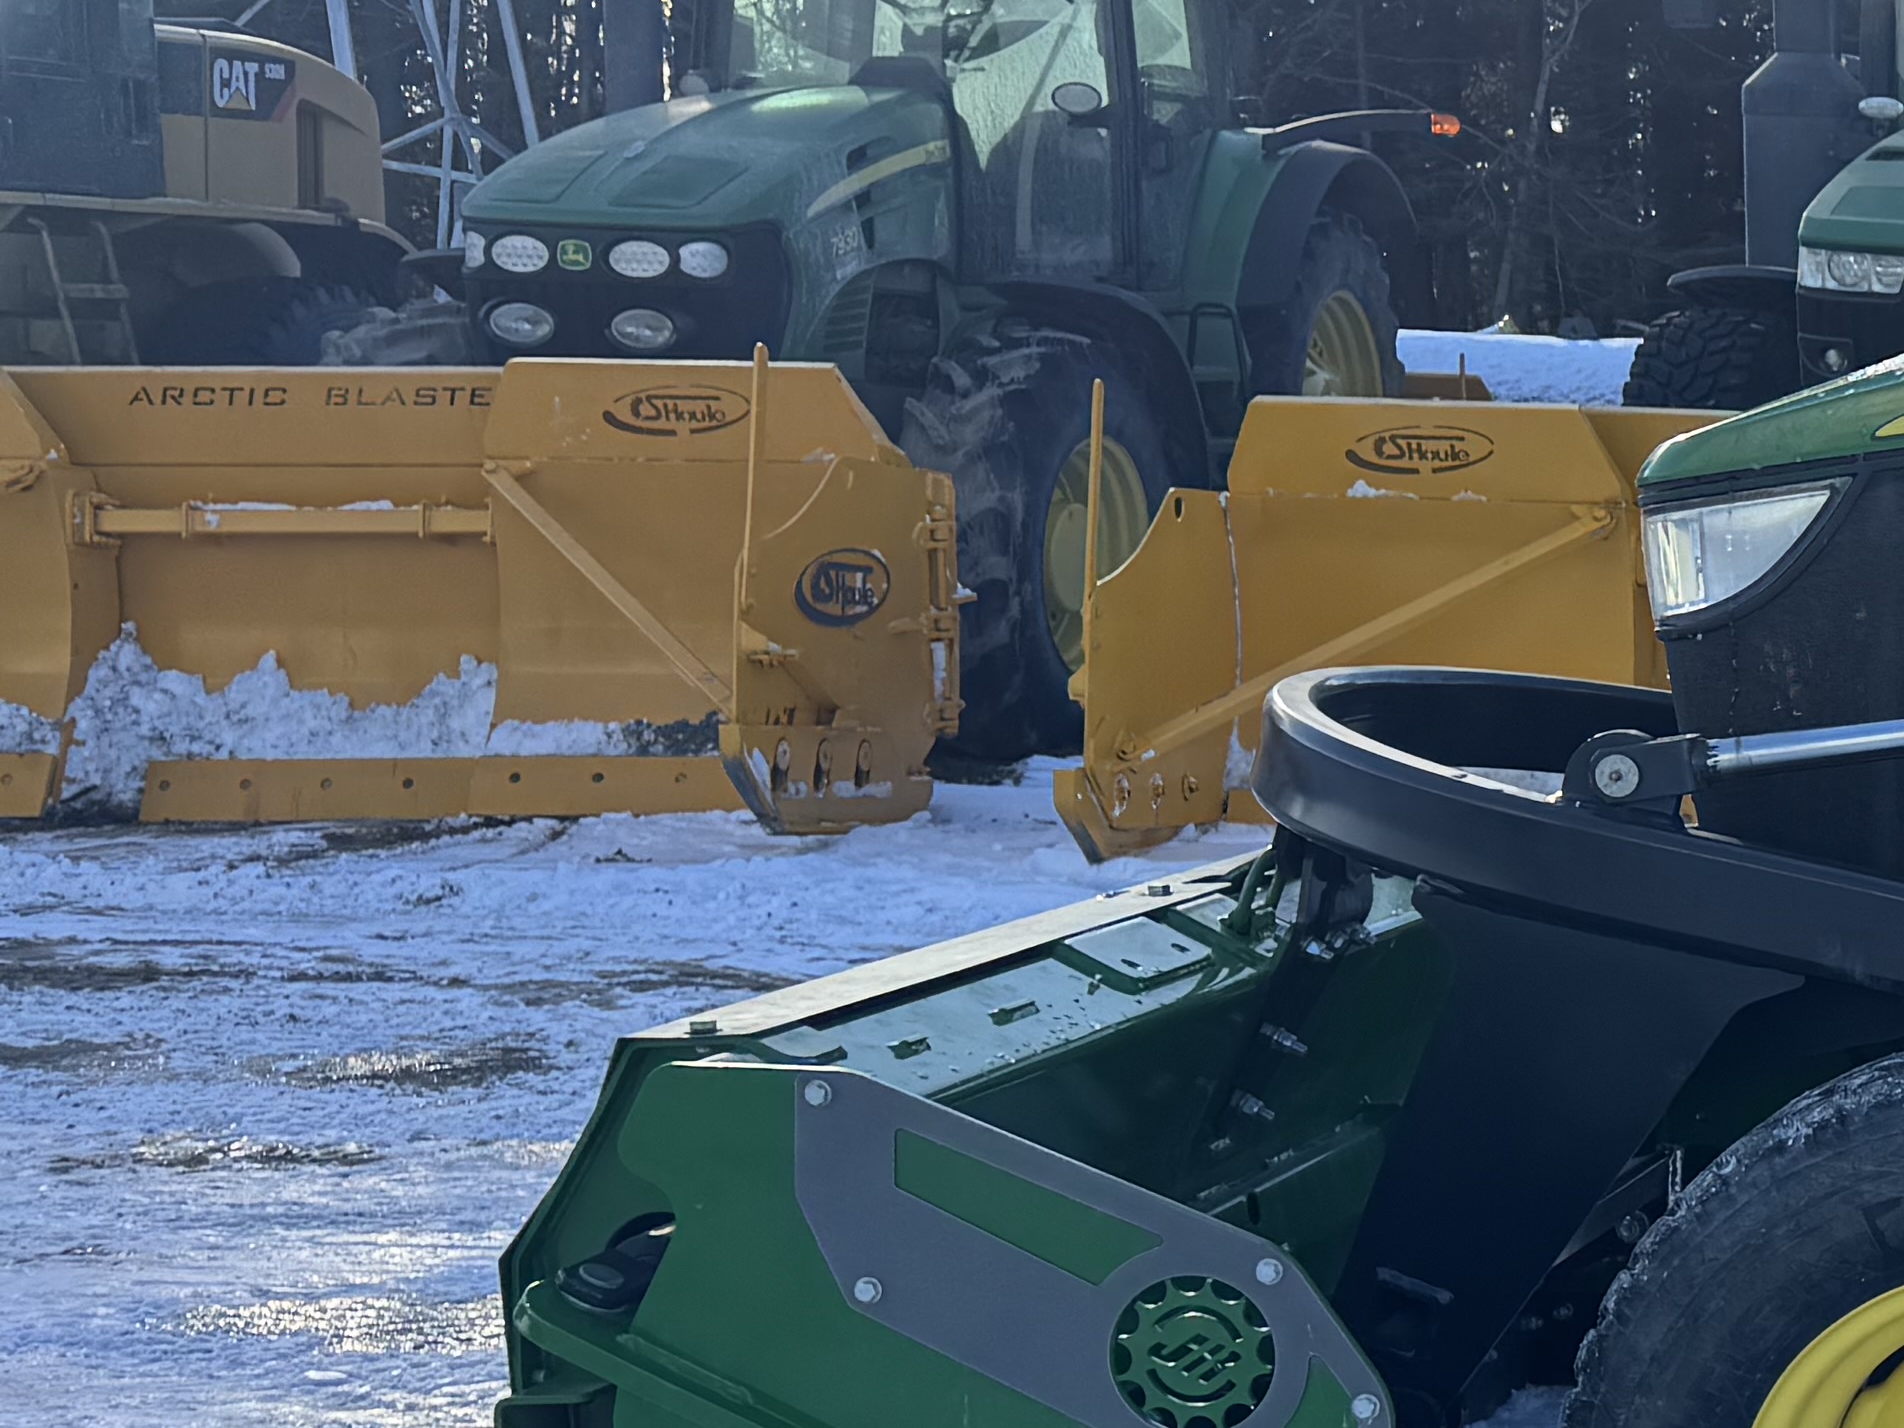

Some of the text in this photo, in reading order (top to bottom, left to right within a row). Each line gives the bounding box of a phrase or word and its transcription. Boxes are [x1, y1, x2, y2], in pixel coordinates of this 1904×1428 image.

[213, 58, 258, 111] CAT
[129, 386, 493, 406] ARCTIC BLASTE
